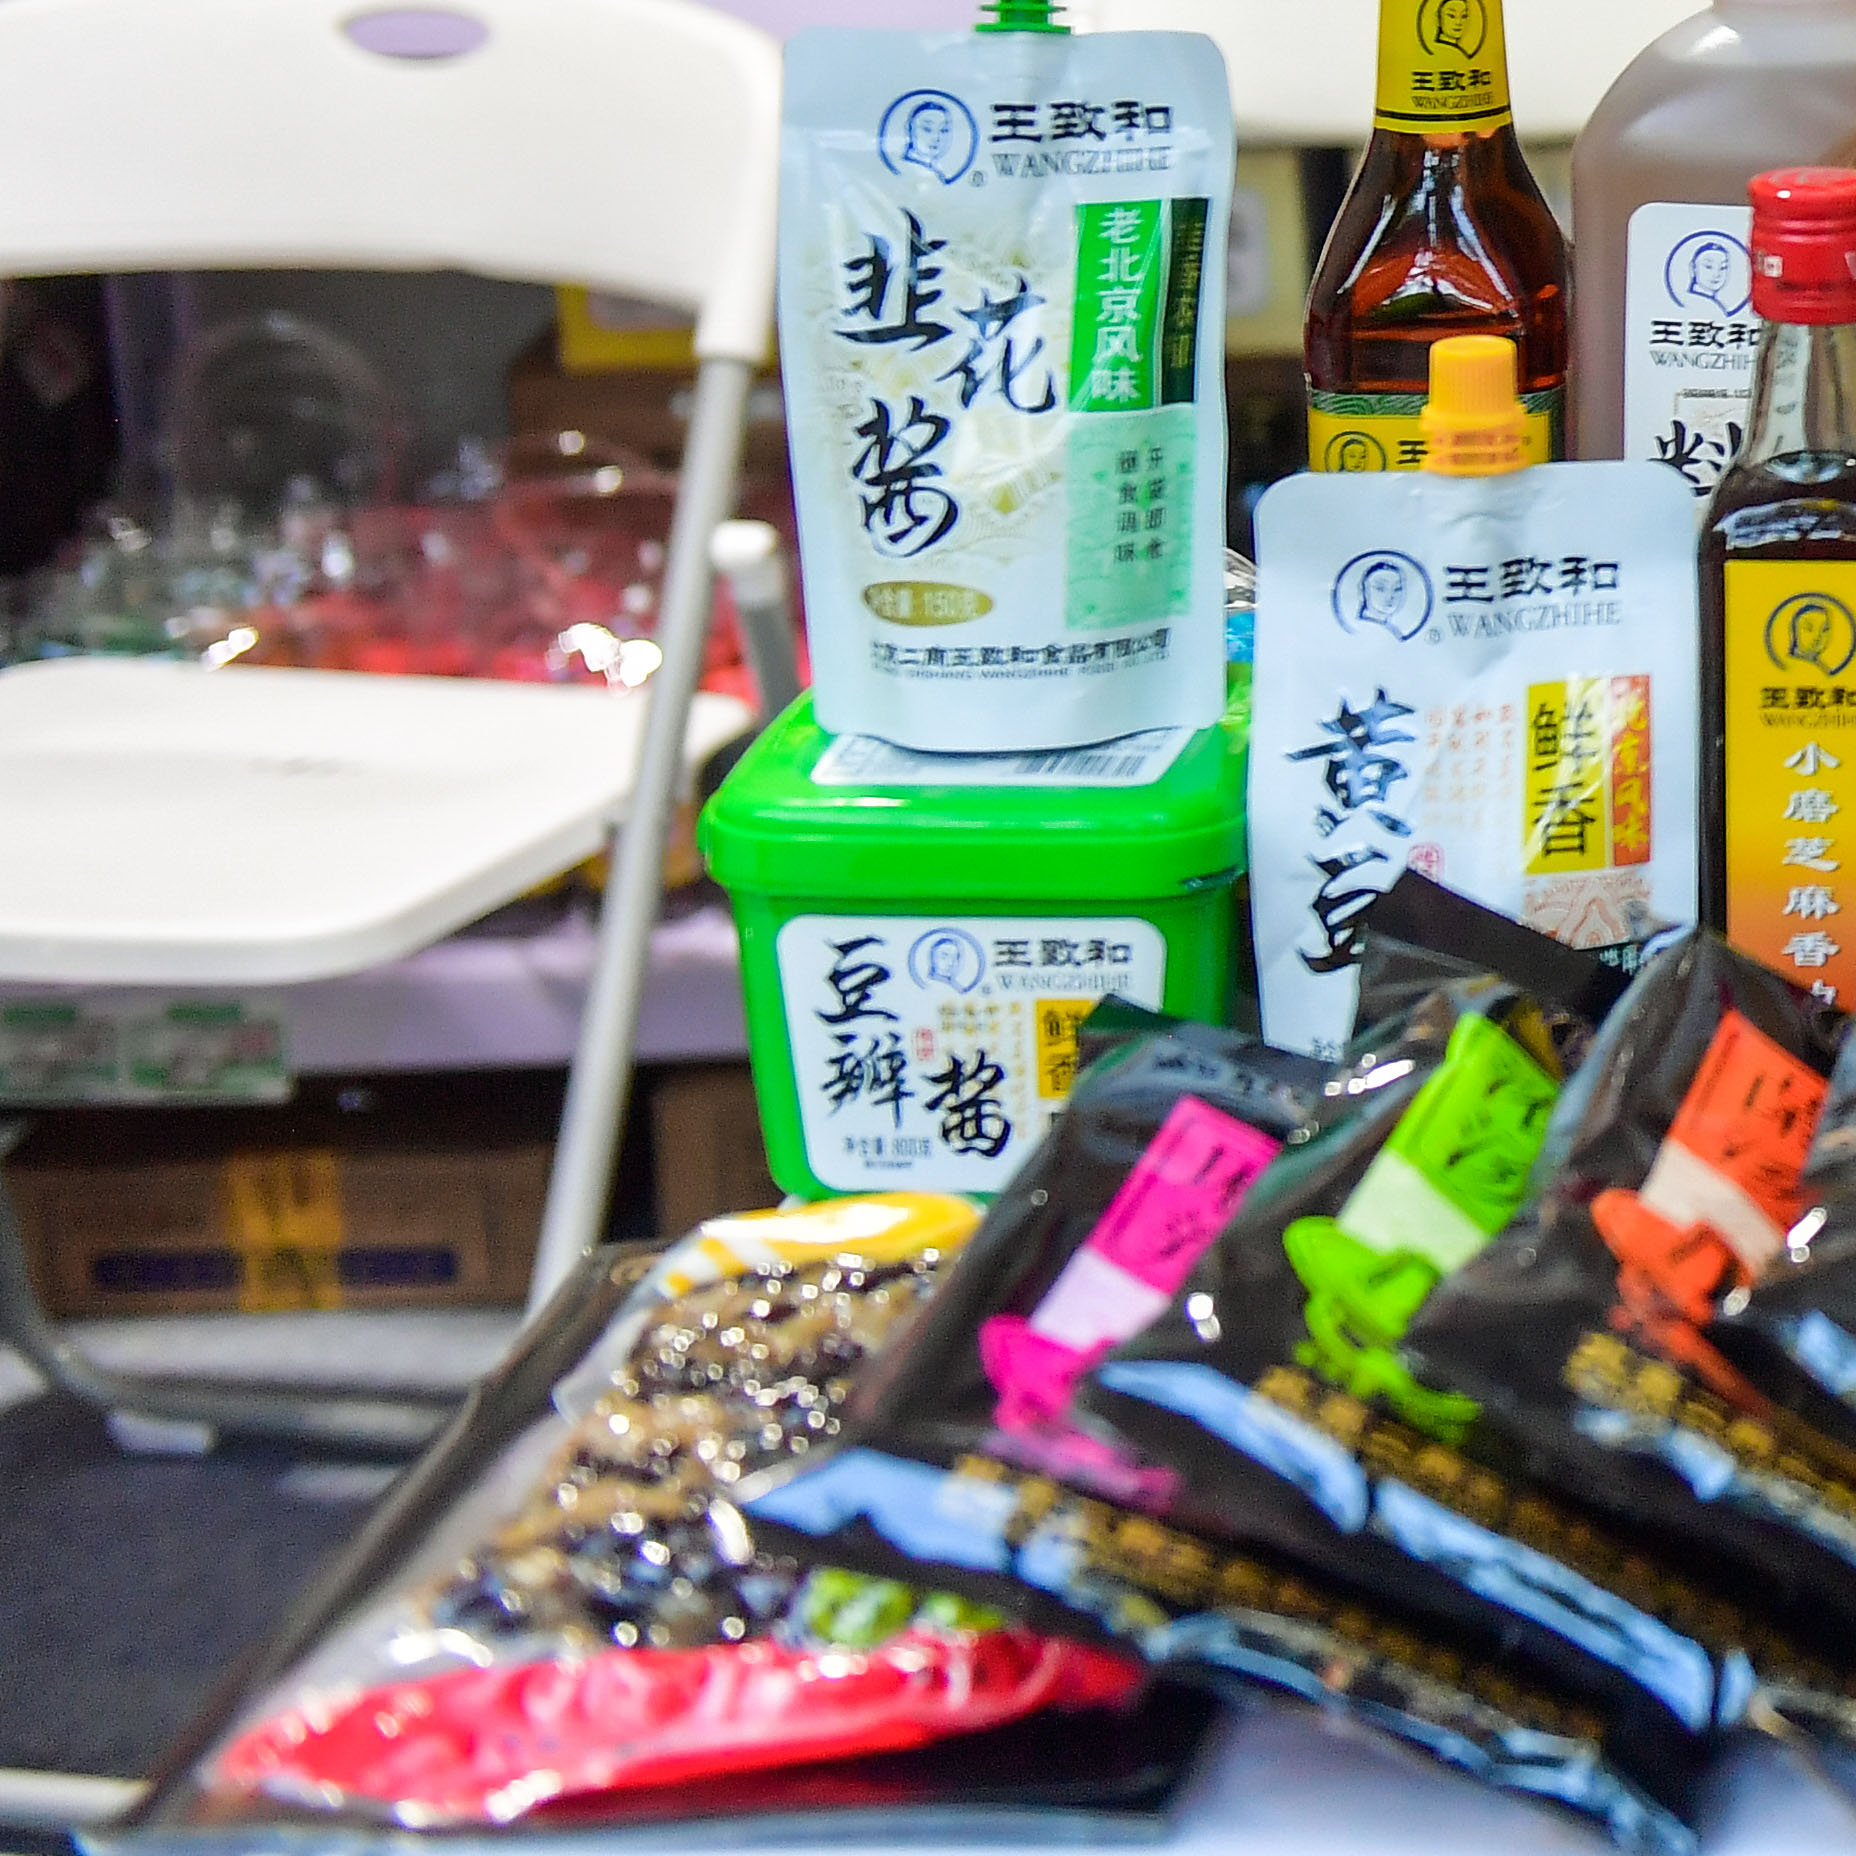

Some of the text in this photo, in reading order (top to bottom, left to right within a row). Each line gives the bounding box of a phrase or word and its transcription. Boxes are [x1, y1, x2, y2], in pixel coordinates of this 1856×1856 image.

[1410, 69, 1492, 92] 王致和
[990, 100, 1175, 145] 王致和
[1089, 207, 1146, 403] 老北京风味
[1649, 320, 1762, 349] 王致和
[1649, 349, 1757, 371] WANGZHIH
[1442, 555, 1621, 605] 王致和
[1446, 600, 1624, 639] WANGZHIHE
[1529, 699, 1599, 860] 鲜香
[992, 936, 1134, 969] 王致和
